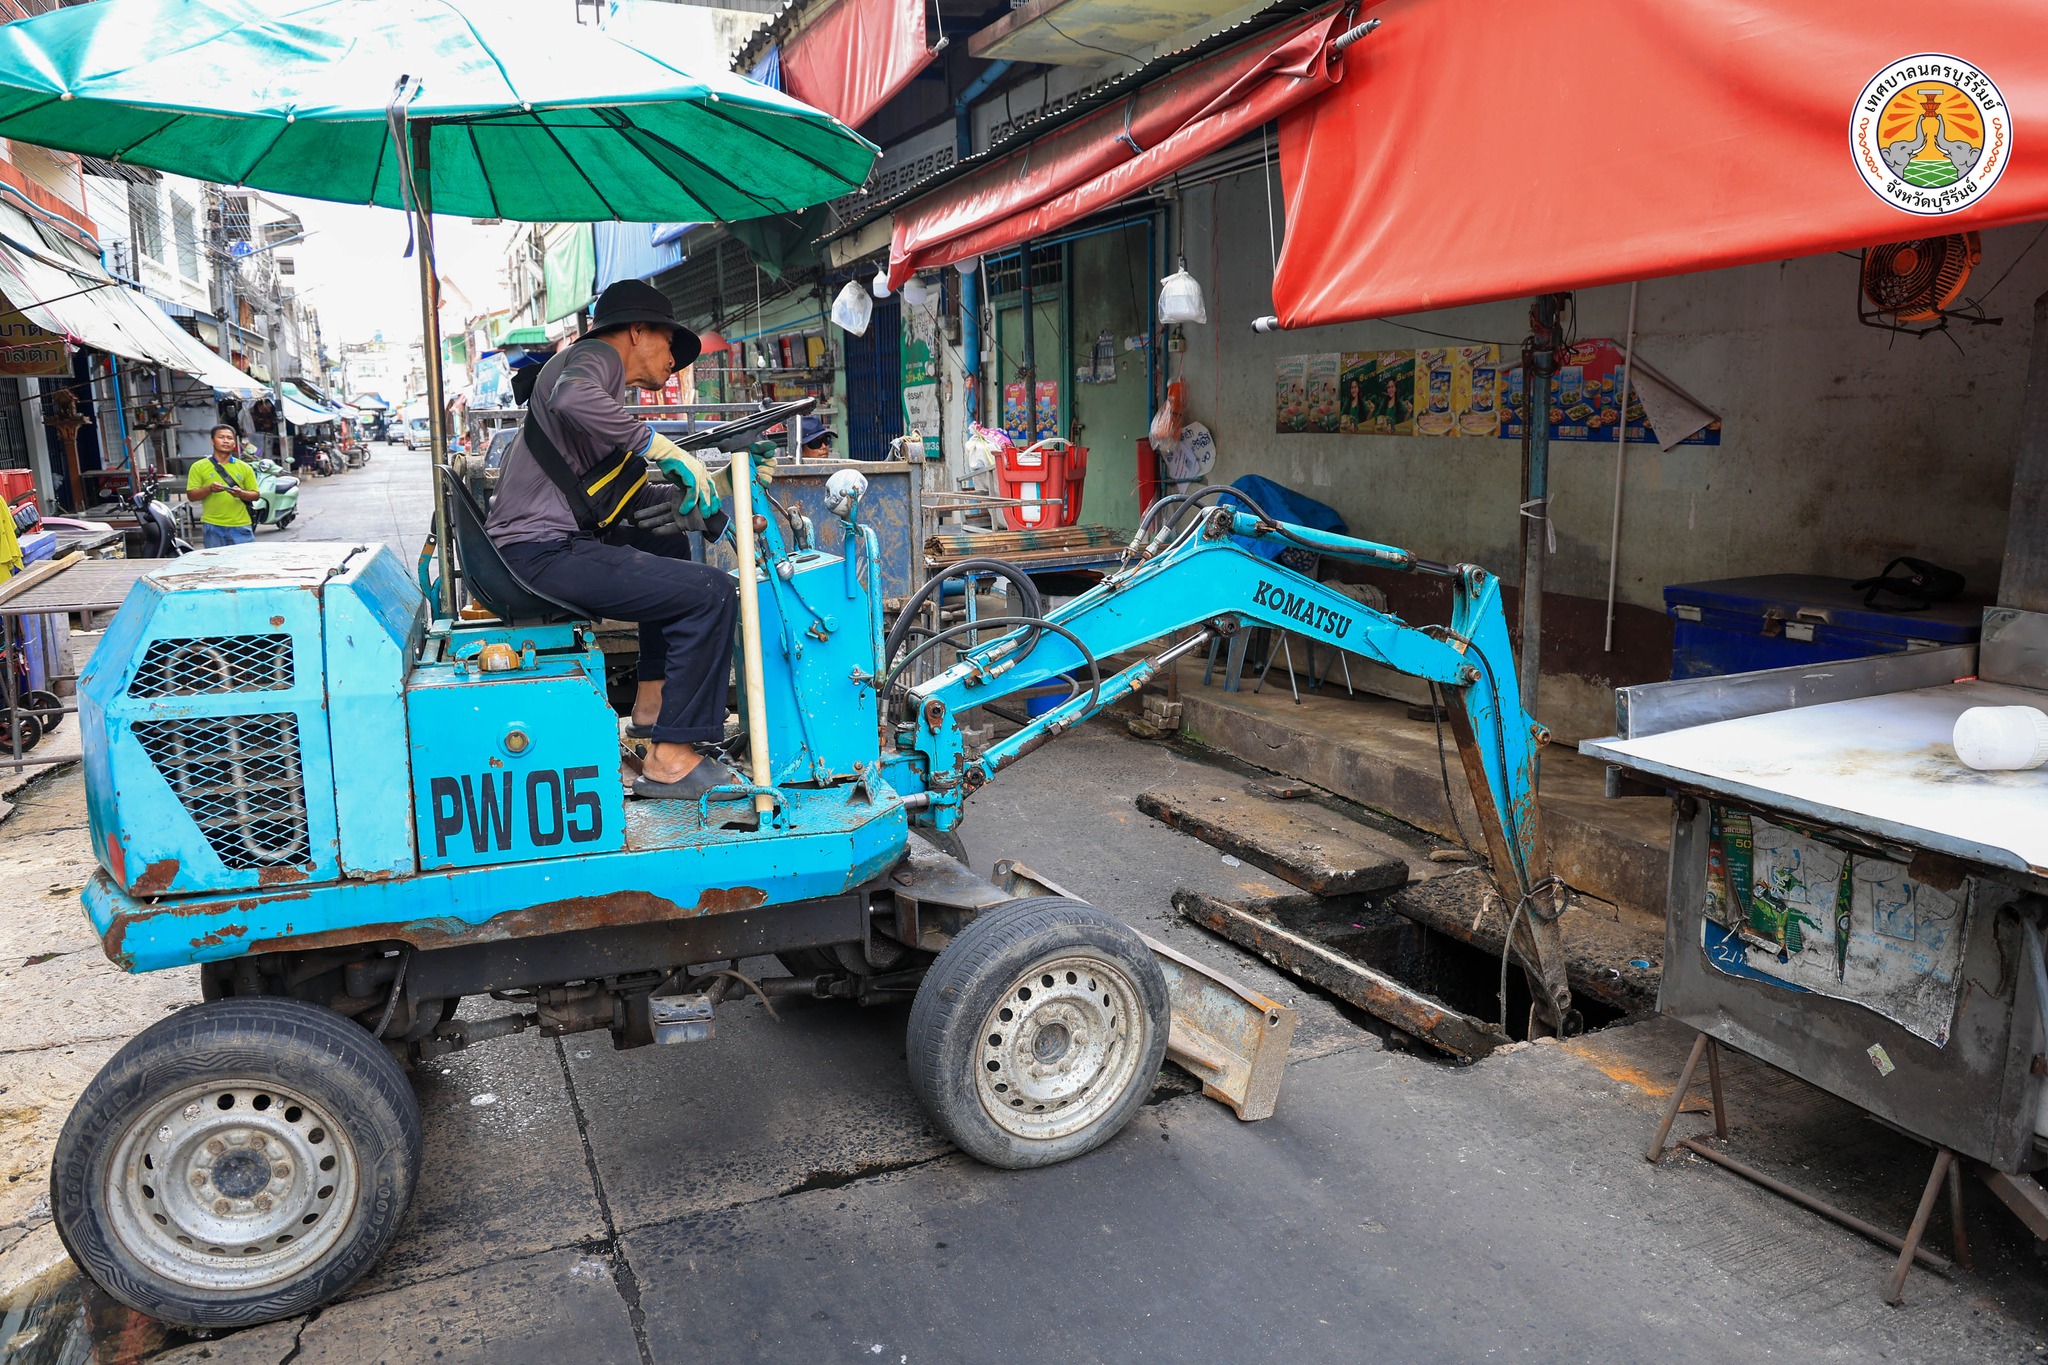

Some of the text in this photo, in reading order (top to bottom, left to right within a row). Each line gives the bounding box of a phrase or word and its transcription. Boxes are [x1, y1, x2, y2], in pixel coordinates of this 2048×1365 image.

[1252, 580, 1353, 639] KOMATSU
[430, 765, 603, 857] PW 05
[1735, 838, 1752, 849] 50
